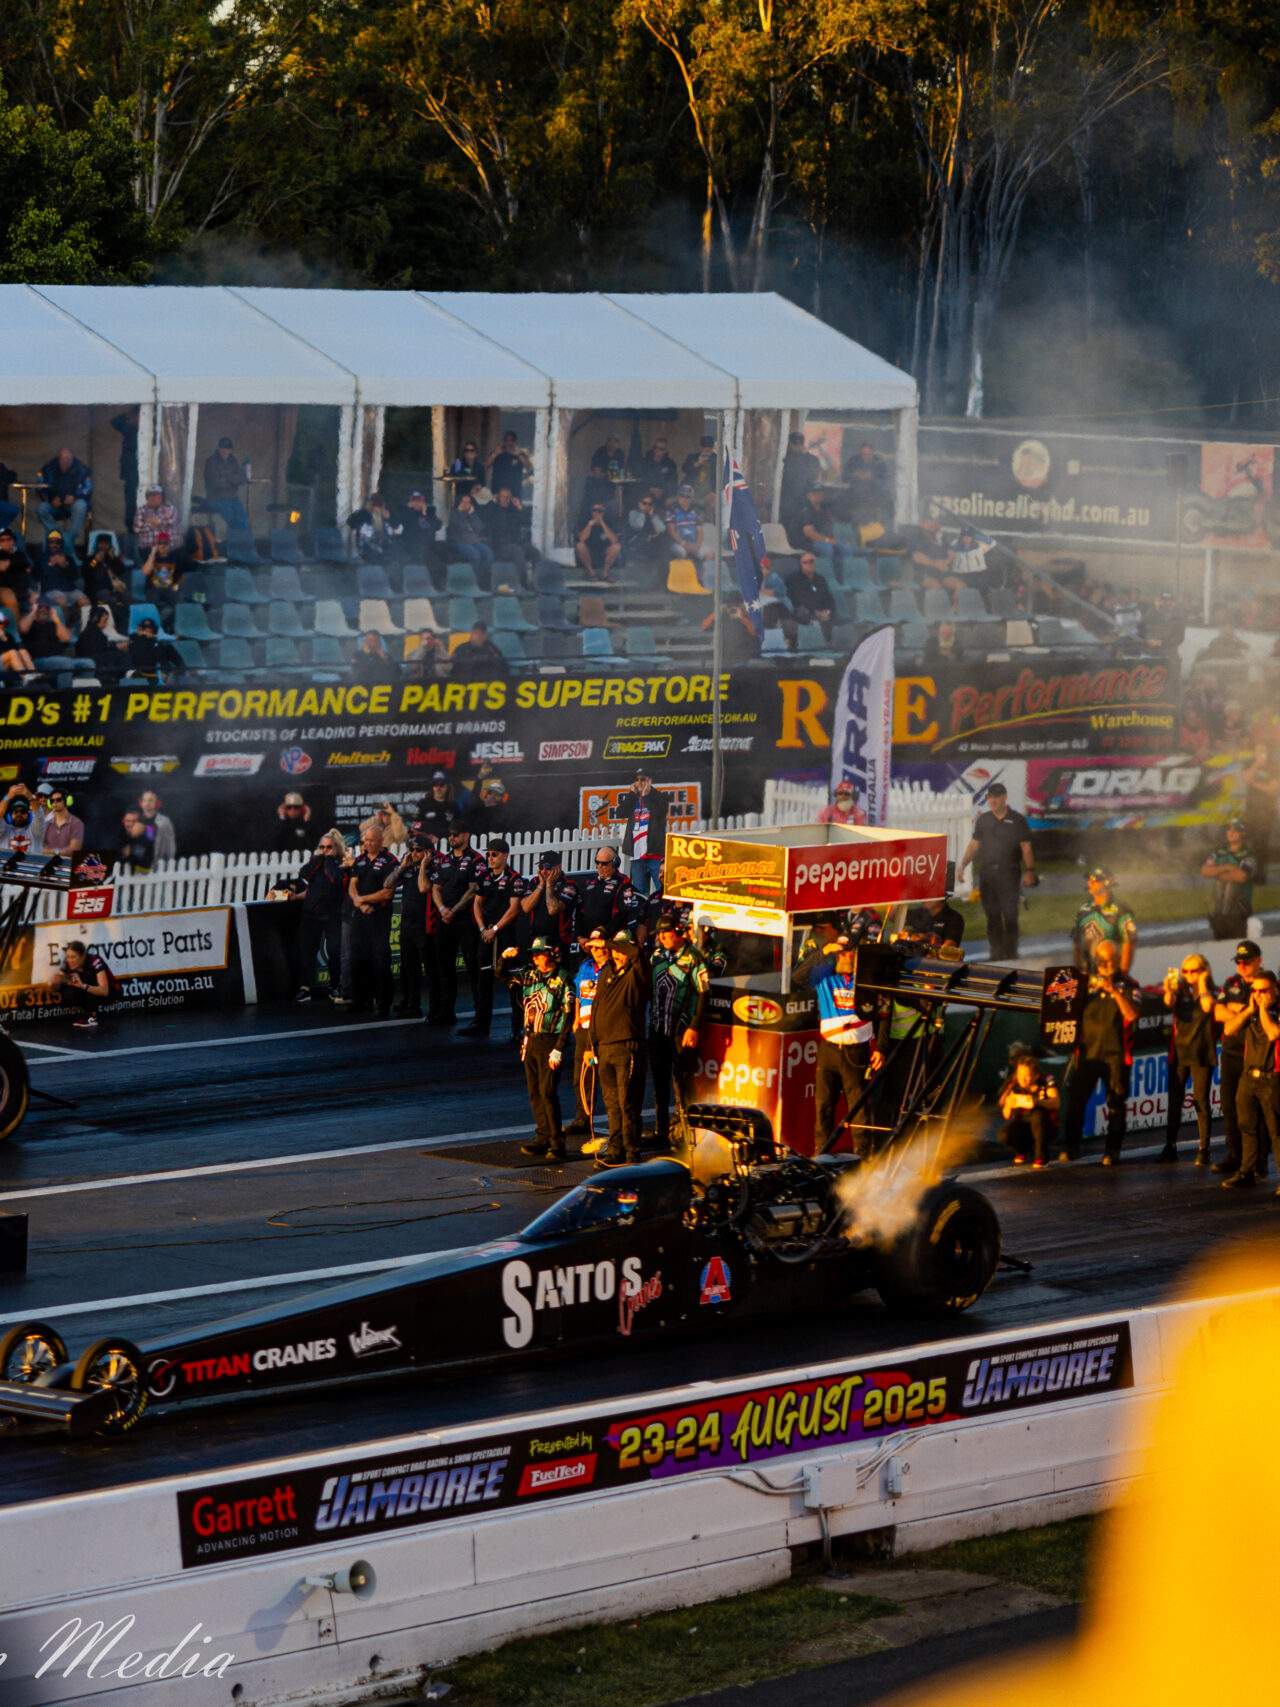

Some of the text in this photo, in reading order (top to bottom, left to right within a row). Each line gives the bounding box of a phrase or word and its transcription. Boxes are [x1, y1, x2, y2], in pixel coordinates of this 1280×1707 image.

[73, 694, 112, 723] #1
[124, 684, 392, 723] PERFORMANCE
[400, 680, 506, 713] PARTS
[516, 674, 730, 709] SUPERSTORE
[950, 667, 1166, 731] Performance
[616, 712, 757, 728] RCEPERFORMANCECOM.AU
[776, 677, 939, 749] RE
[1090, 711, 1174, 730] Warehouse
[205, 720, 506, 743] STOCKISTS OF LEADING PERFORMANCE BRANDS
[327, 750, 391, 765] Haltech
[406, 748, 457, 769] Holley
[471, 741, 524, 759] JESEL
[541, 741, 590, 760] SIMPSON
[617, 740, 666, 753] RACEPAK
[1070, 766, 1201, 795] DRAG
[672, 837, 723, 862] RCE
[674, 860, 777, 883] Performance
[795, 853, 940, 895] peppermoney
[73, 897, 107, 914] 526
[48, 929, 212, 967] Eavator Parts
[122, 975, 214, 997] rdw.com.au
[0, 991, 18, 1009] 07
[12, 1008, 35, 1022] Total
[148, 993, 184, 1007] Solution
[785, 999, 815, 1014] GULF
[502, 1256, 642, 1349] SANTOS
[182, 1353, 251, 1384] TITAN
[252, 1337, 337, 1371] CRANES
[961, 1346, 1117, 1408] JAMBOREE
[620, 1375, 947, 1469] 23-24 AUGUST 2025
[580, 1434, 593, 1450] by
[363, 1469, 381, 1481] SPORT
[381, 1463, 410, 1477] COMPACT
[427, 1456, 449, 1469] RACING
[472, 1445, 512, 1462] SPECTACULAR
[531, 1462, 585, 1487] FuelTech
[314, 1459, 508, 1532] JAMBOREE
[192, 1484, 297, 1537] Garrett
[197, 1526, 299, 1554] ADVANCING MOTION
